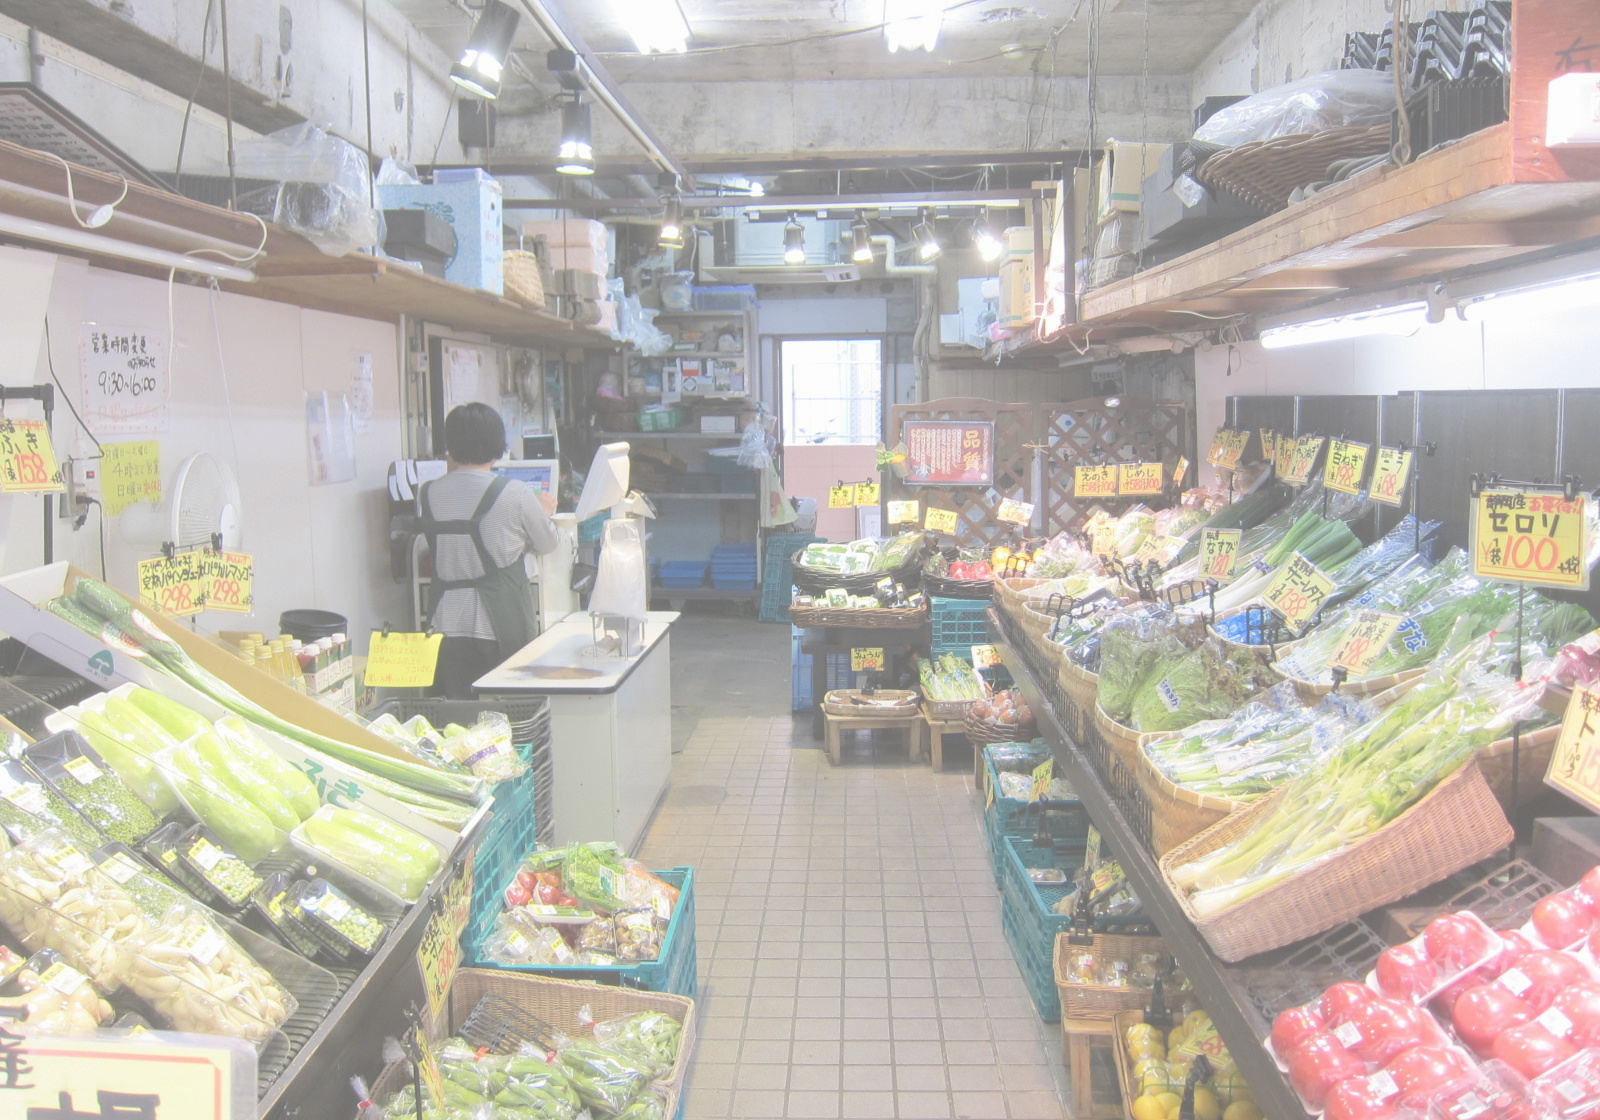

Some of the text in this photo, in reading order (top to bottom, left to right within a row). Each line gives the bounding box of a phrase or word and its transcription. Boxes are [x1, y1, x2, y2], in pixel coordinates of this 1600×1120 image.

[91, 332, 146, 355] 営業時間変更
[963, 430, 981, 472] 品質
[1333, 451, 1363, 470] 白ねぎ
[14, 453, 48, 484] 158
[1081, 468, 1108, 480] えのき
[1126, 469, 1155, 479] しめじ
[1334, 465, 1355, 487] 198
[1382, 473, 1397, 496] 68
[1488, 508, 1560, 538] セロリ
[1206, 540, 1238, 555] なすび
[1502, 535, 1559, 570] 100
[161, 583, 192, 612] 298
[213, 579, 241, 605] 298
[1285, 565, 1325, 606] サニーレタス
[1275, 587, 1308, 617] 138
